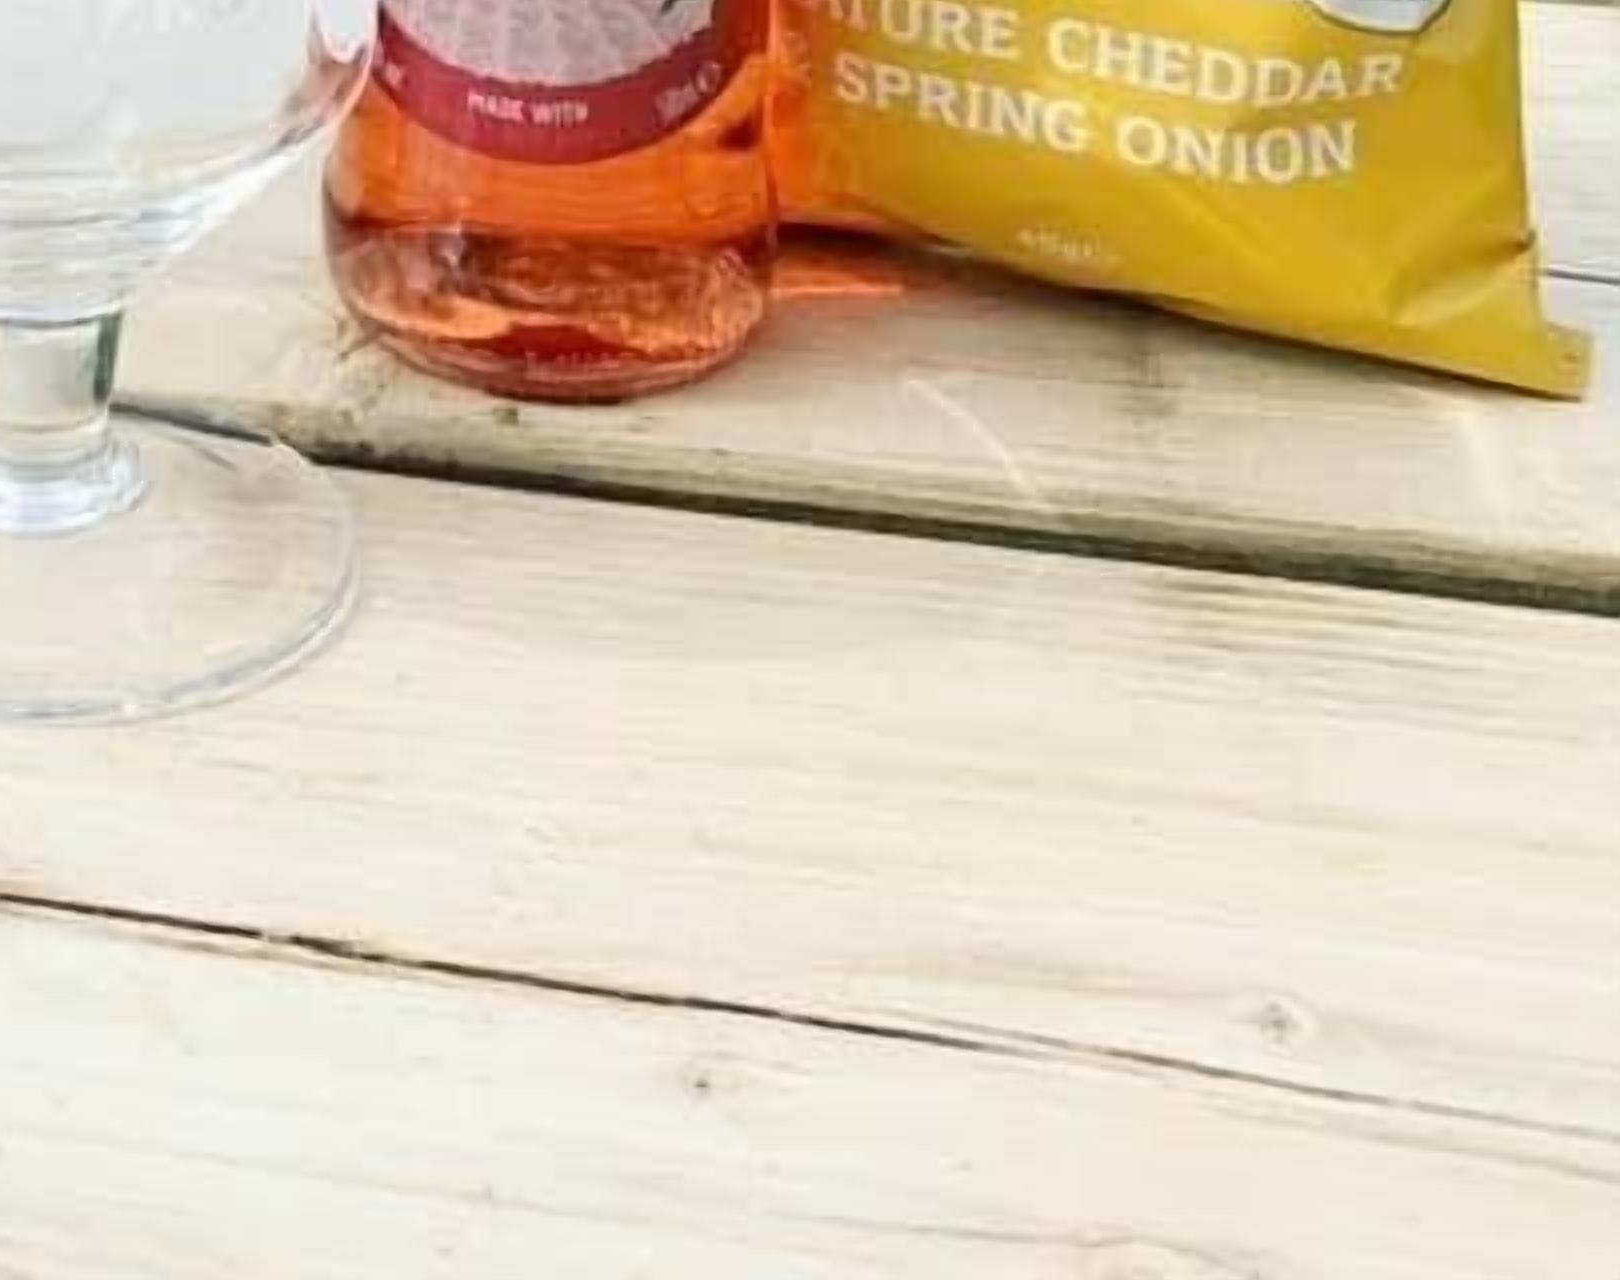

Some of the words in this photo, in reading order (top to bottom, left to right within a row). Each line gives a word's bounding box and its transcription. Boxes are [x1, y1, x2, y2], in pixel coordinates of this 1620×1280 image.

[835, 50, 1090, 155] SPRING
[1117, 119, 1358, 185] ONION
[1048, 19, 1404, 108] CHEDDAR
